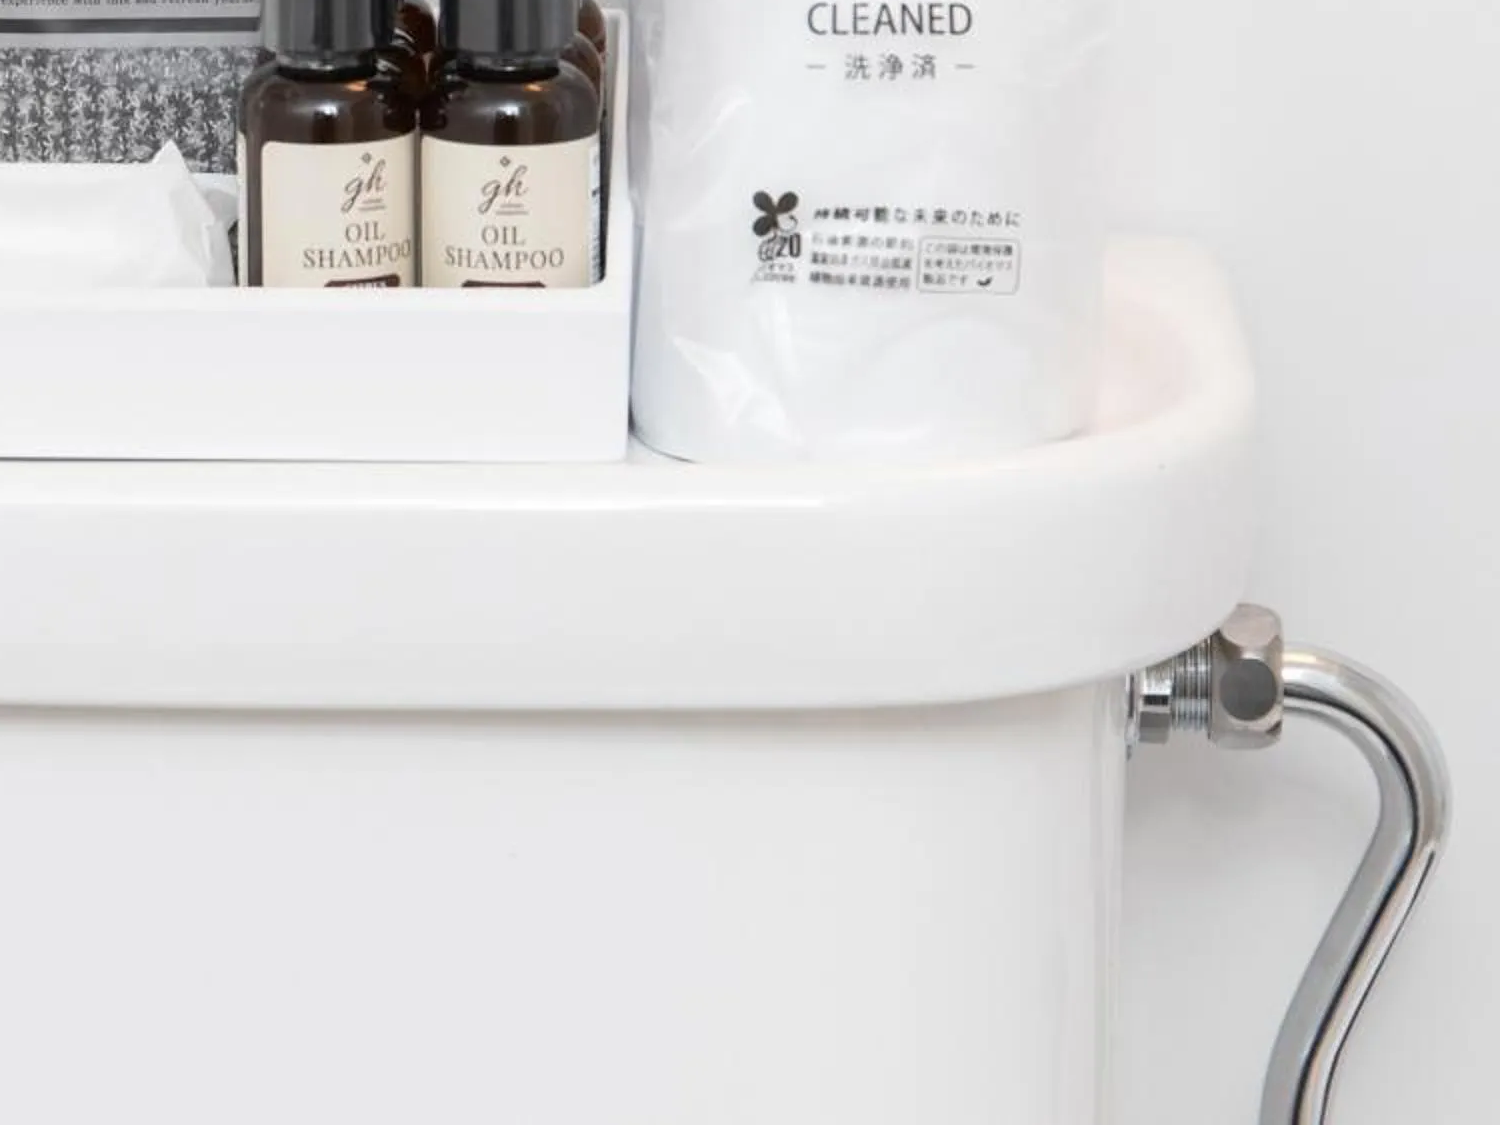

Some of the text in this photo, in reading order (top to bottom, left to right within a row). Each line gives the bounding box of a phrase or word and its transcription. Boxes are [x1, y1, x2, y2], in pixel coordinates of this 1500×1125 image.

[807, 1, 974, 37] CLEANED
[344, 222, 386, 244] OIL
[480, 225, 527, 247] OIL
[303, 238, 412, 270] SHAMPOO
[443, 245, 565, 271] SHAMPOO
